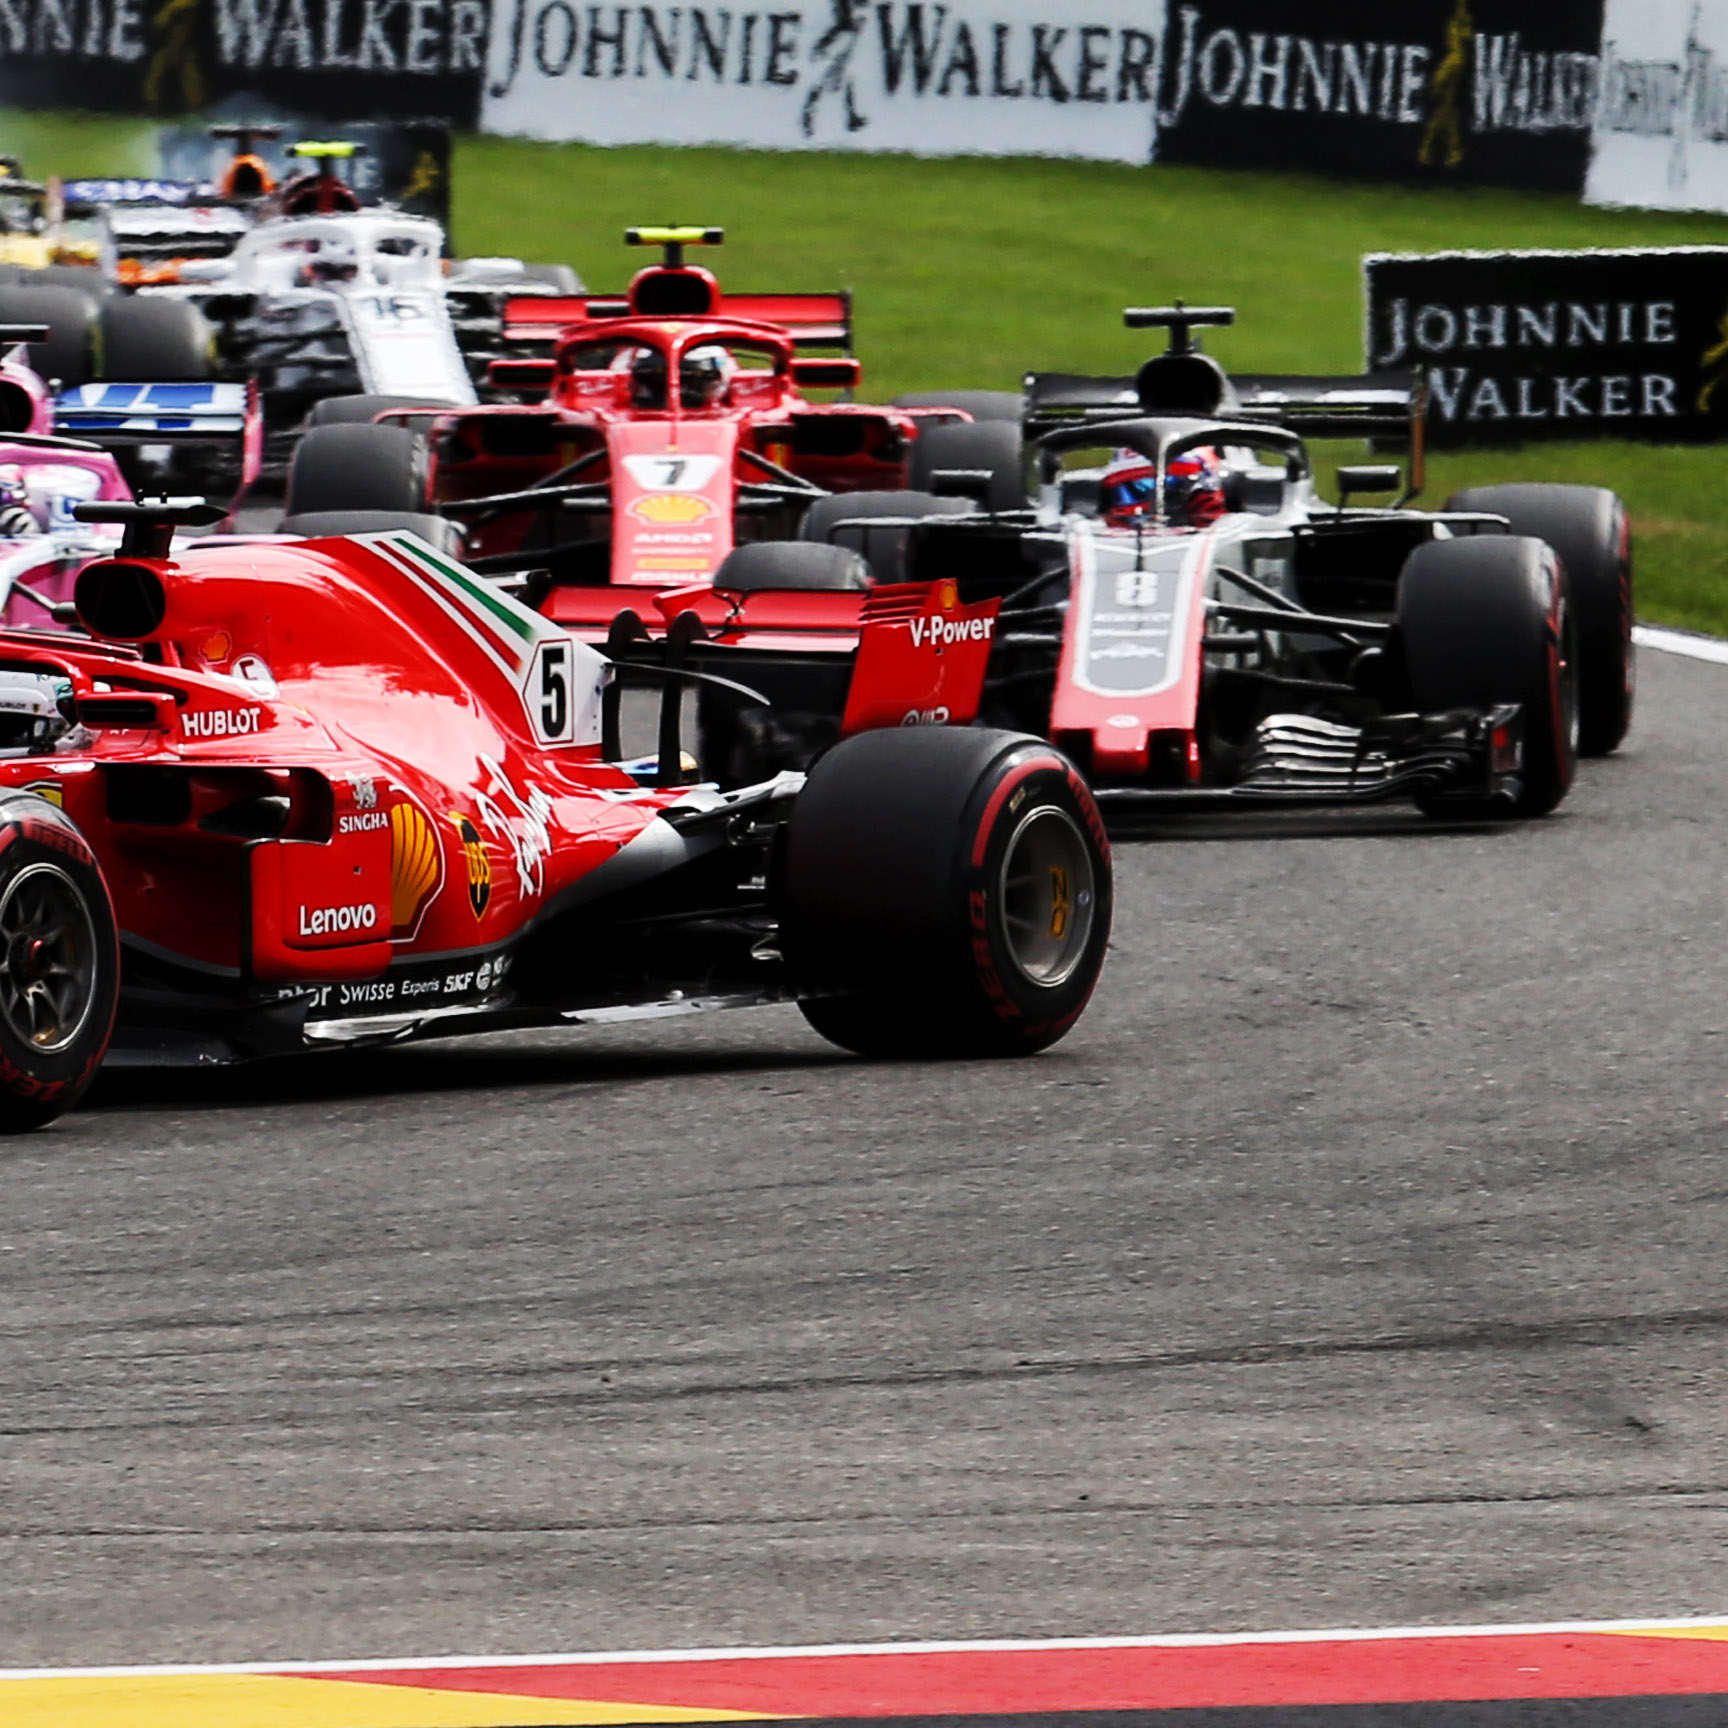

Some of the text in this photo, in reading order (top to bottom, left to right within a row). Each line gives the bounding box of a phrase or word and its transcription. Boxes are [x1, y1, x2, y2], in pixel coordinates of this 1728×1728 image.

[877, 0, 1156, 104] WALKER
[1158, 5, 1431, 126] JOHNNIE
[1378, 298, 1677, 363] JOHNNIE
[1424, 367, 1678, 422] WALKER
[653, 459, 689, 486] 7
[1115, 571, 1159, 607] 8
[908, 615, 995, 648] V-Power
[541, 646, 567, 739] 5
[181, 706, 261, 737] HUBLOT
[338, 811, 388, 834] SINGHA
[299, 902, 377, 937] Lenovo
[340, 982, 394, 1005] Swisse
[443, 971, 474, 993] SKF
